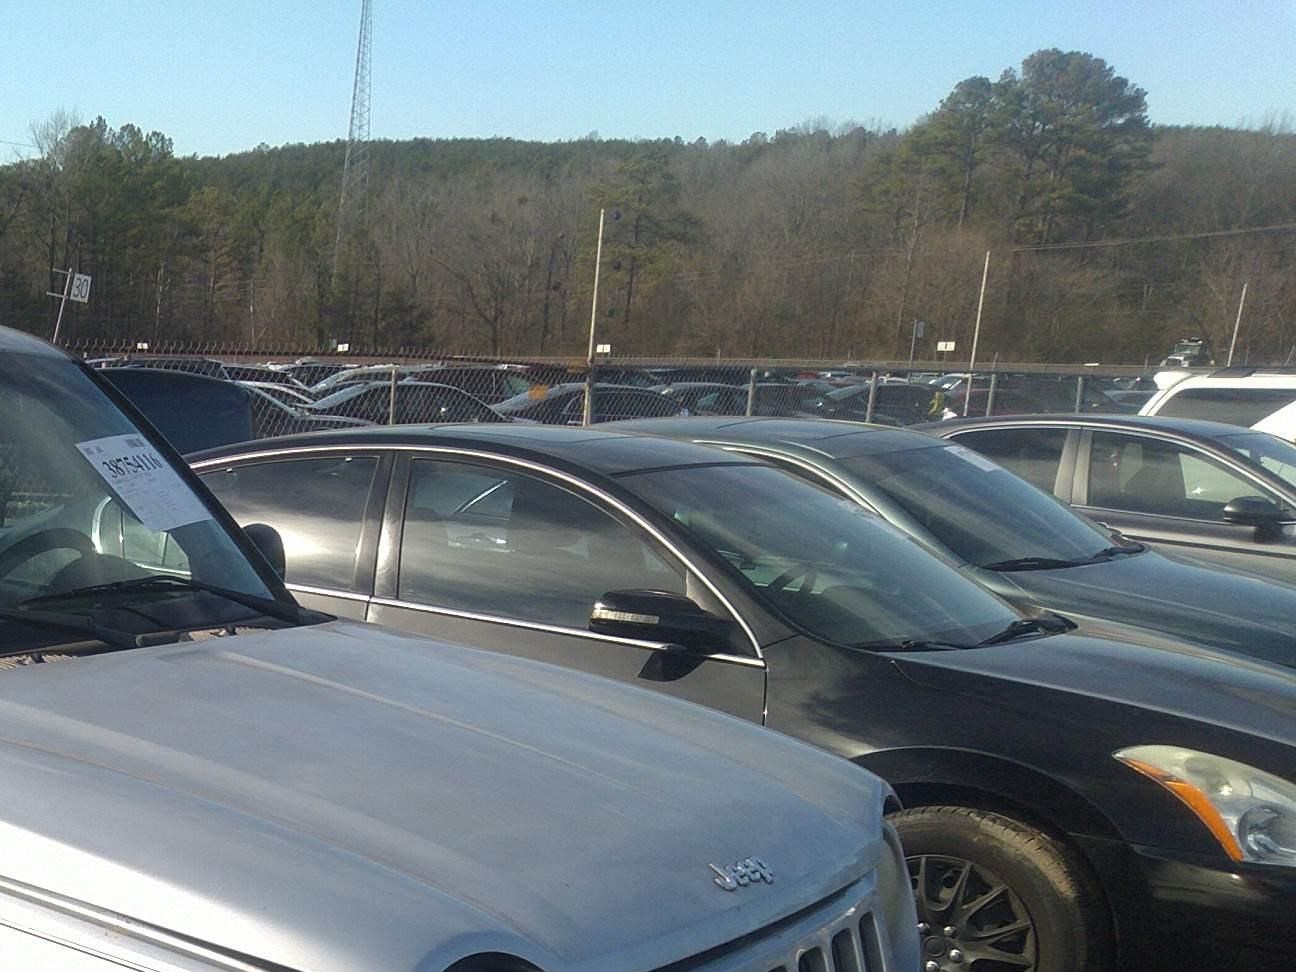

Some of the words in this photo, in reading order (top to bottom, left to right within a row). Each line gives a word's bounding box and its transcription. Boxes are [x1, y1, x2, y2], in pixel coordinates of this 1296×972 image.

[73, 277, 89, 298] 30
[102, 452, 164, 479] 38754116
[708, 856, 774, 892] Jeep
